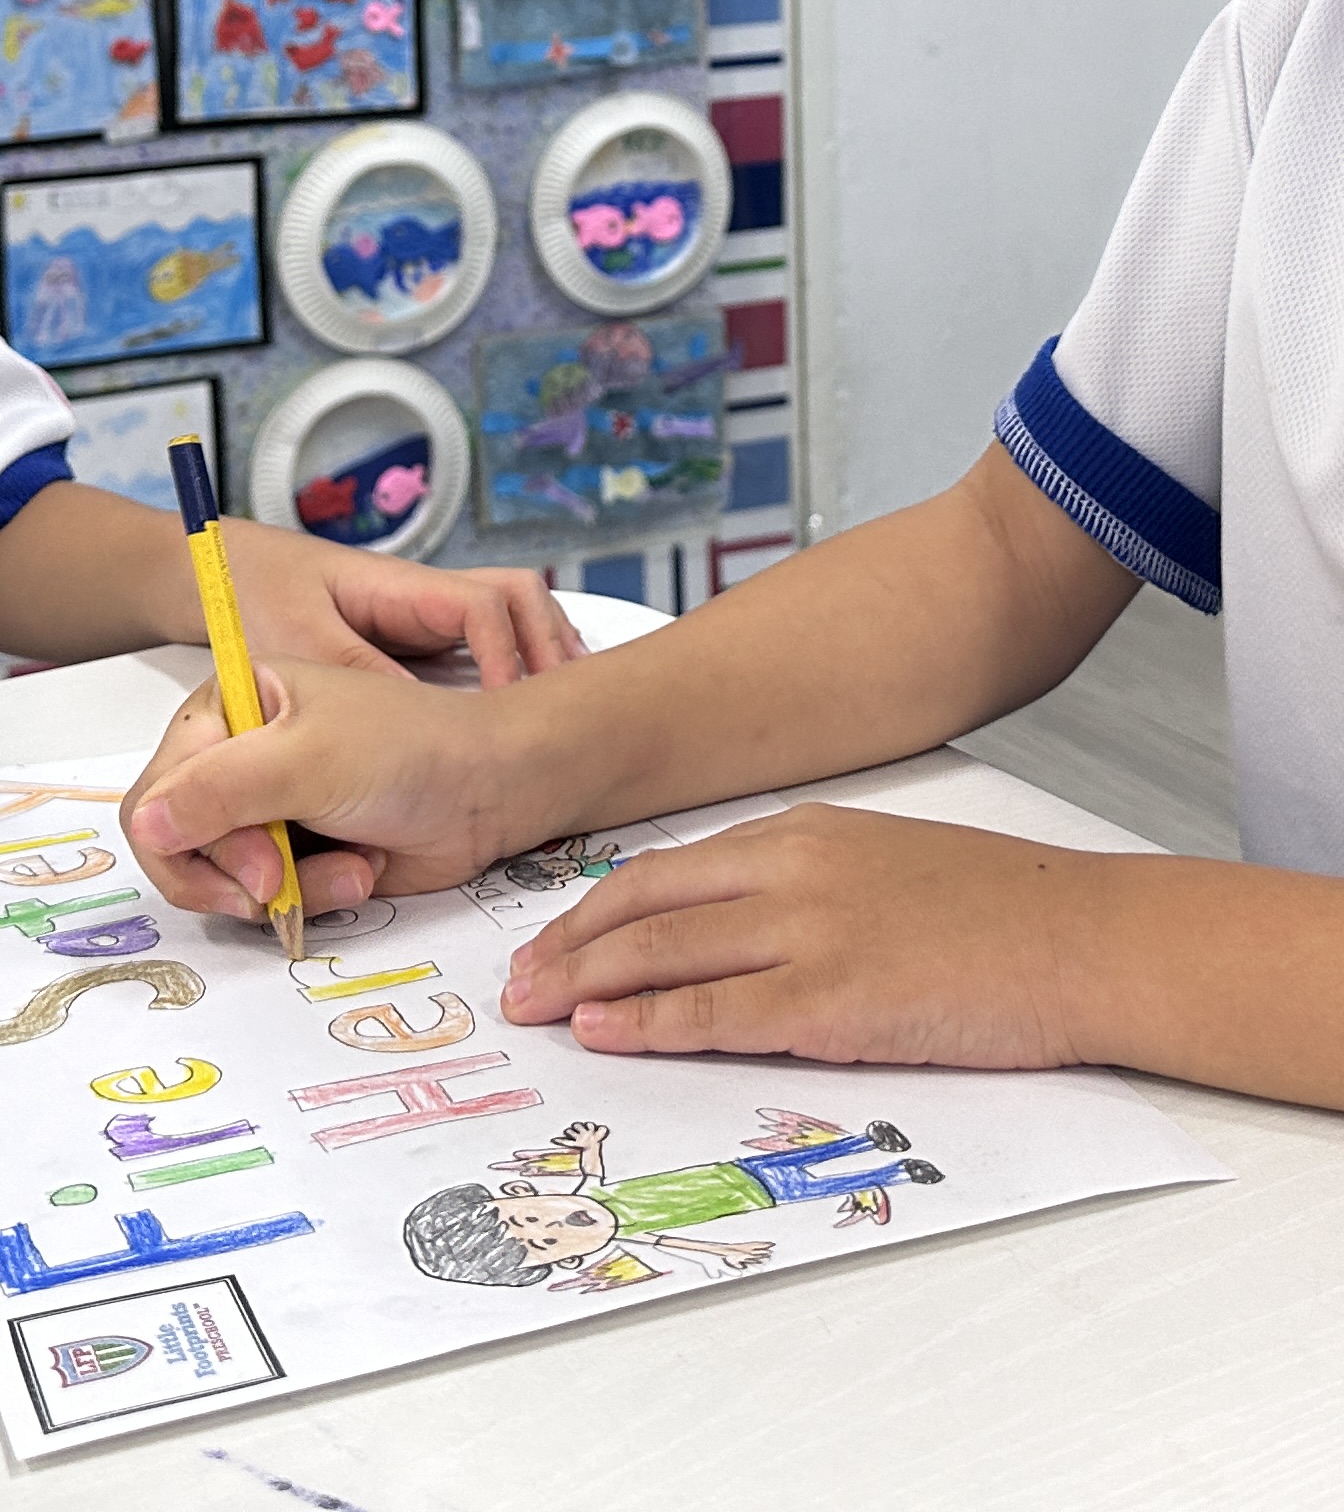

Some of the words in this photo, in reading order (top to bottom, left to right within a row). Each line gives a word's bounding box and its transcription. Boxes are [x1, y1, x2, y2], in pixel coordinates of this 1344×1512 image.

[258, 896, 544, 1153] Hero
[156, 1322, 188, 1365] Little
[171, 1300, 217, 1379] Footprints
